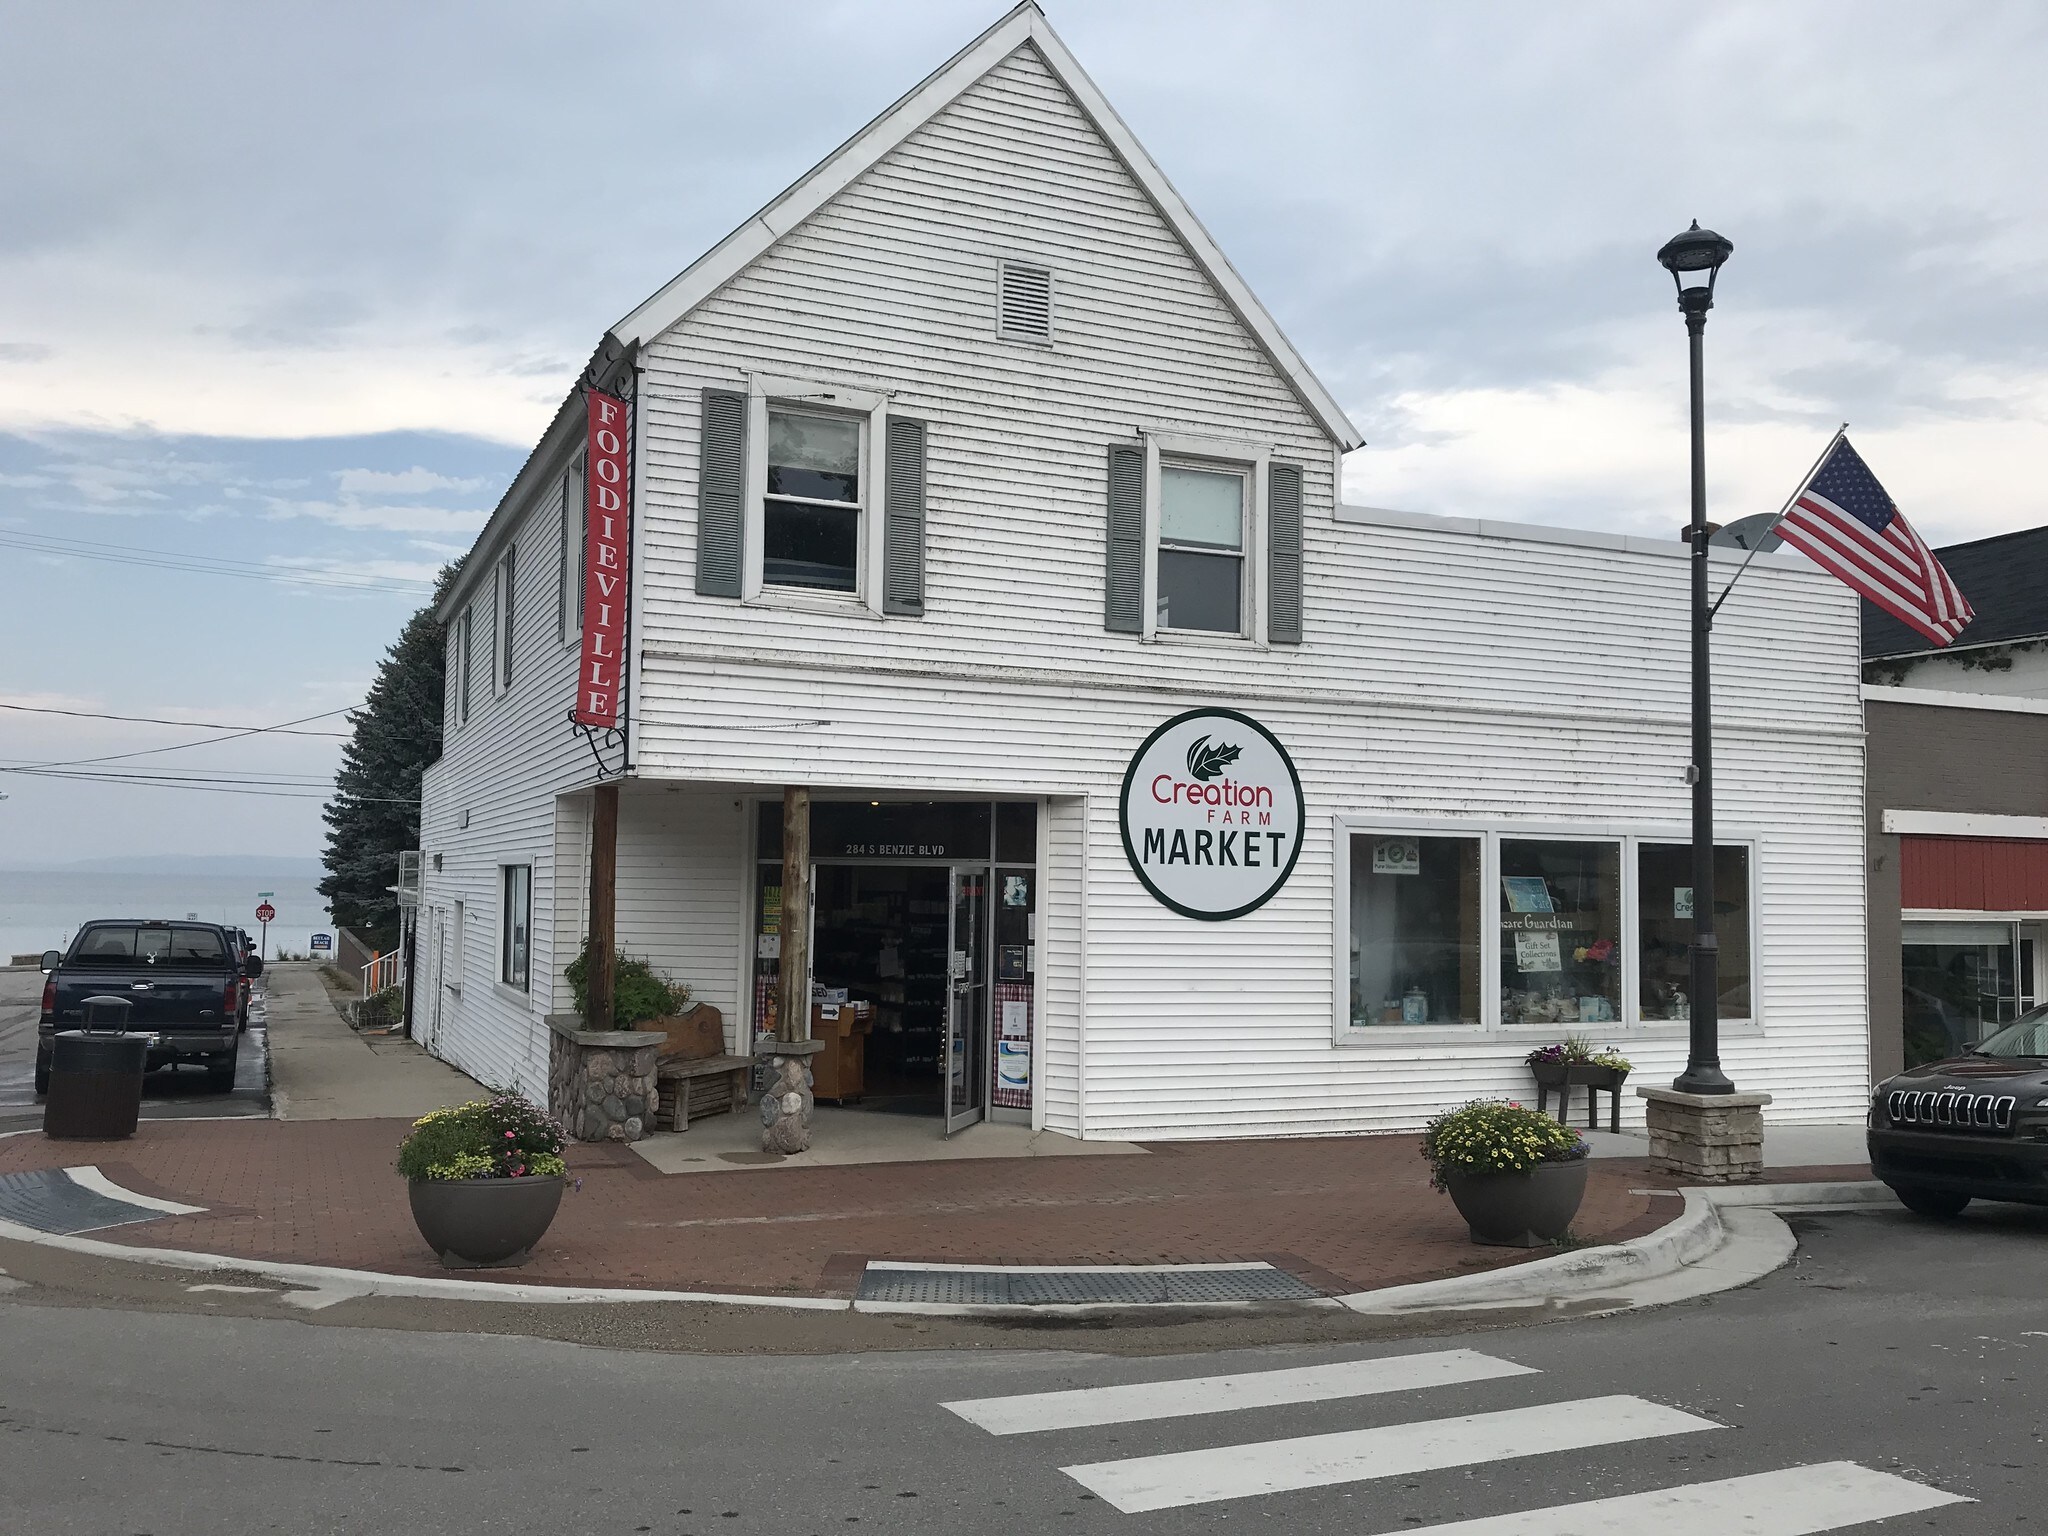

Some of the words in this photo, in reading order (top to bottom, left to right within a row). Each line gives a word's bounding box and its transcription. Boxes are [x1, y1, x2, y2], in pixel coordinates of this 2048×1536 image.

[588, 399, 621, 716] FOODIEVILLE
[1151, 774, 1273, 808] Creation
[1207, 809, 1271, 826] FARM
[846, 844, 865, 855] 284
[869, 844, 875, 855] S
[880, 844, 915, 855] BENZIE
[919, 845, 945, 855] BLVD
[1143, 827, 1286, 868] MARKET
[257, 909, 274, 917] STOP
[1524, 913, 1573, 929] Guardian
[1525, 942, 1538, 950] Gift
[1520, 951, 1557, 959] Collections
